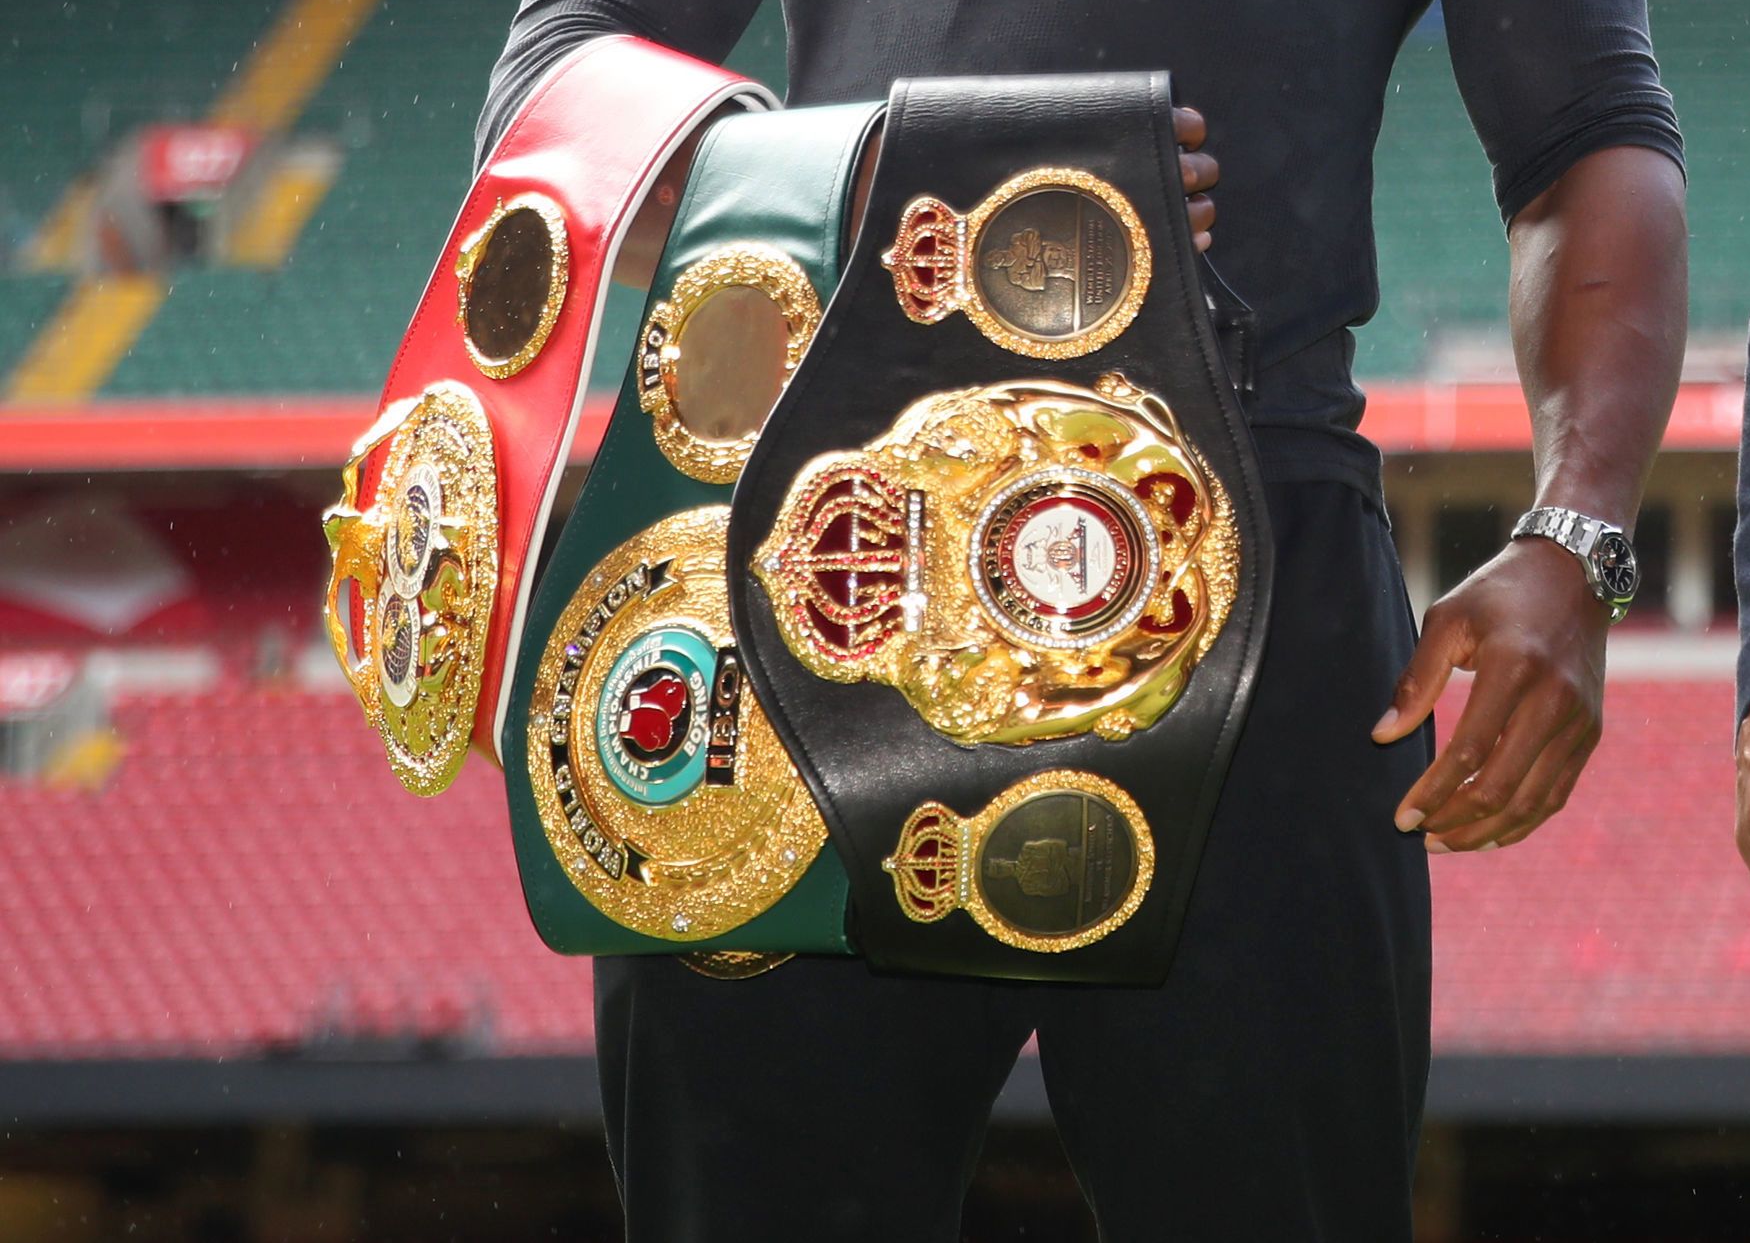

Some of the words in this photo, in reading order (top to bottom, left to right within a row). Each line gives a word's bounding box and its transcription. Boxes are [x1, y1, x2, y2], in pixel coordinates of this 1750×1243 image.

[643, 329, 664, 386] IBO
[551, 564, 647, 745] CHAMPION
[608, 649, 662, 781] CHAMPIONSHIP
[683, 670, 708, 757] BOXING
[709, 656, 741, 768] IBO
[555, 764, 620, 879] WORLD
